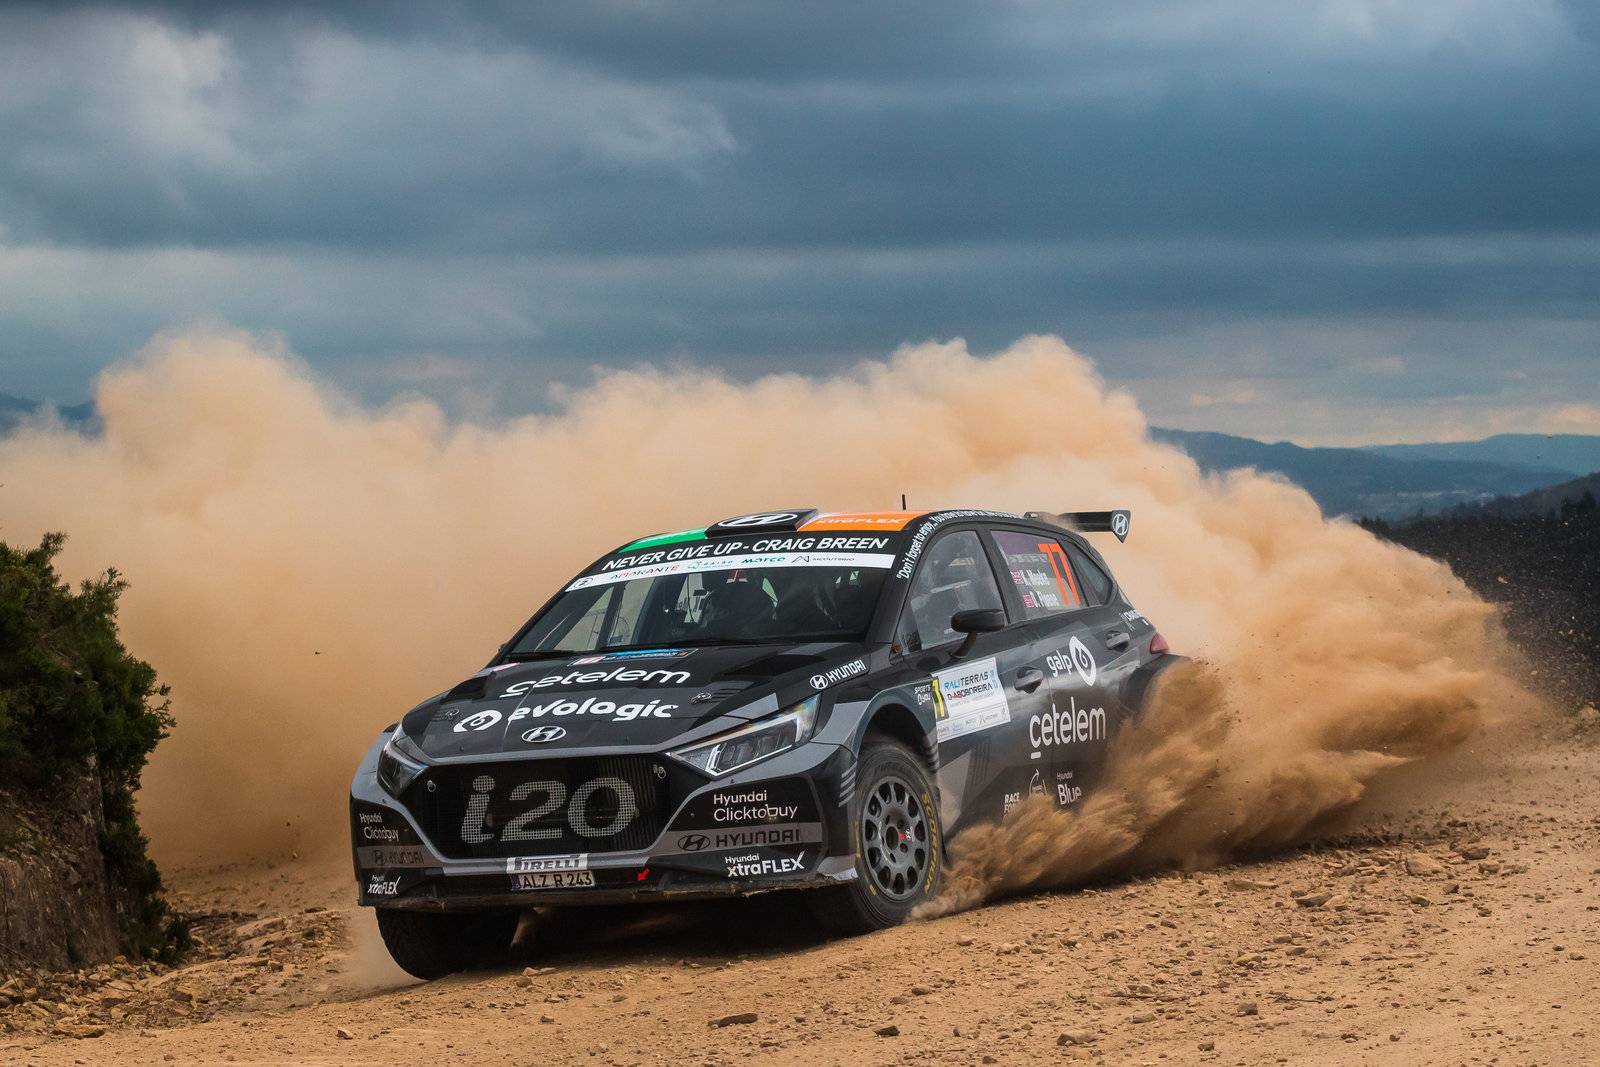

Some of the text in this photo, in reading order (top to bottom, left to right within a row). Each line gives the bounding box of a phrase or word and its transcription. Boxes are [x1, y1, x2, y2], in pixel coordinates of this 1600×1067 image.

[601, 551, 666, 571] NEVER
[666, 544, 714, 561] GIVE
[713, 542, 743, 555] UP
[752, 537, 816, 552] CRAIG
[816, 537, 889, 549] BREEN
[905, 538, 923, 560] forget
[1037, 544, 1081, 606] 77
[825, 659, 867, 682] HYUNDAI
[1046, 649, 1073, 678] galp
[499, 666, 691, 698] cetelem
[508, 697, 679, 722] evologic
[1029, 696, 1106, 750] cetelem
[713, 789, 768, 806] Hyundai
[1004, 792, 1020, 804] RACE
[1057, 783, 1082, 806] Blue
[460, 775, 636, 844] i20
[716, 828, 800, 848] HYUNDAI
[920, 792, 938, 894] SCORPION
[725, 853, 760, 864] Hyundai
[726, 850, 805, 878] xtraFLEX
[523, 871, 593, 889] ALZ R 243
